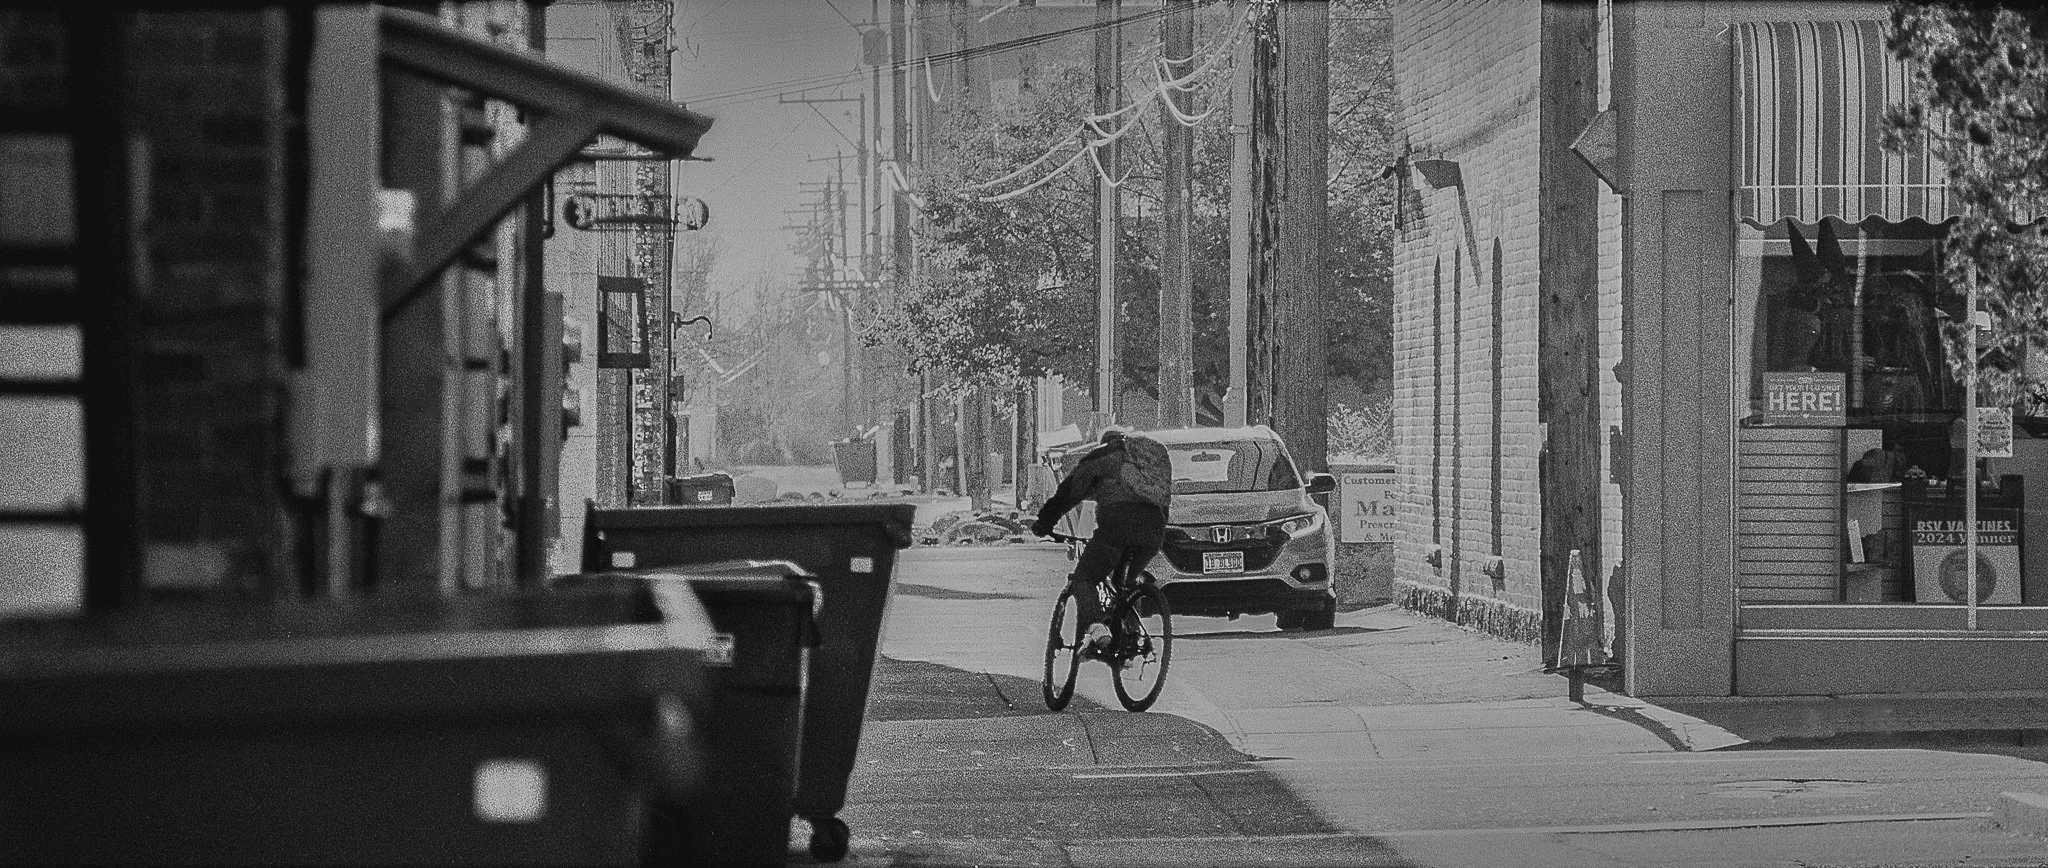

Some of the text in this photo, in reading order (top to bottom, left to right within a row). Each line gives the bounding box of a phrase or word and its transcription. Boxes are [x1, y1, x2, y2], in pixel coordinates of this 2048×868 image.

[1769, 391, 1841, 411] HERE!
[1354, 501, 1396, 517] Ma
[1917, 520, 2011, 531] RSV VACINES
[1917, 533, 1955, 543] 2024
